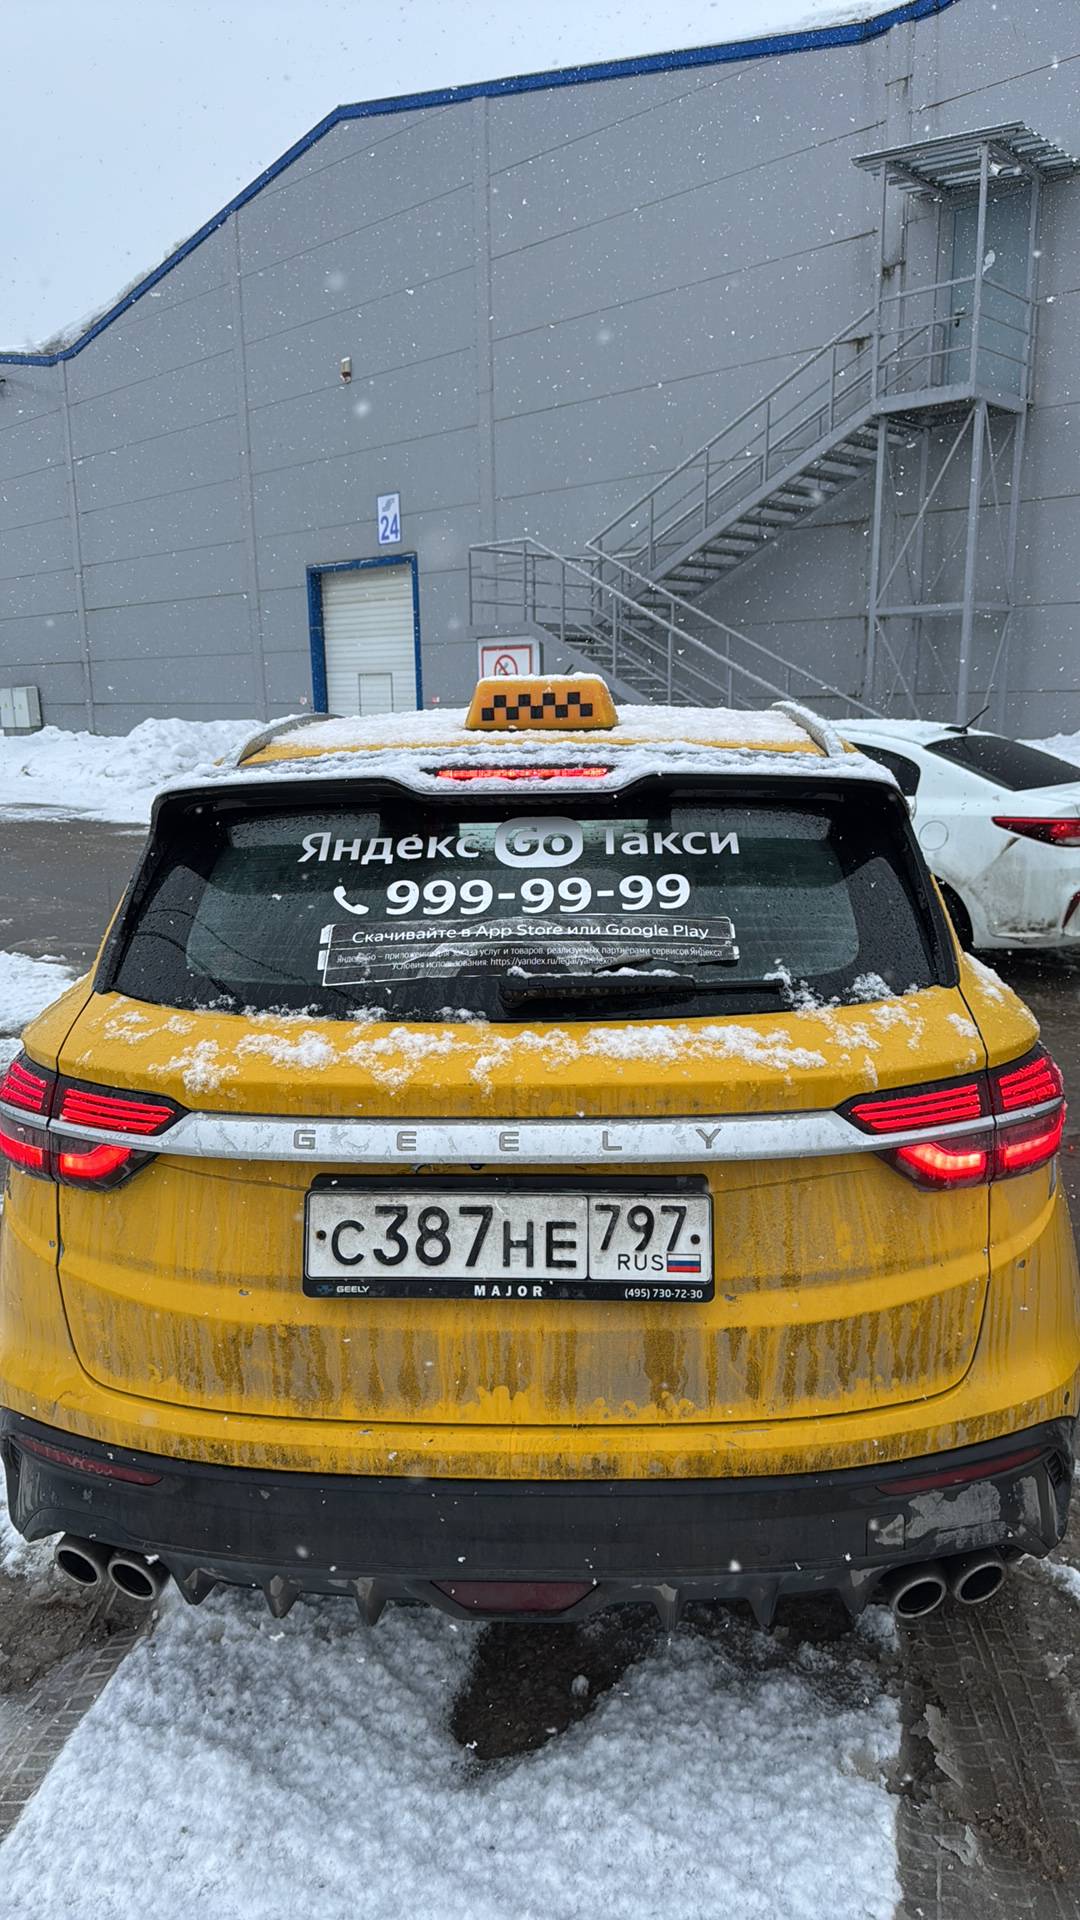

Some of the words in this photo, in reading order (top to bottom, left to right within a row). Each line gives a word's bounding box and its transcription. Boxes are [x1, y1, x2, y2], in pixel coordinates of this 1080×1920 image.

[380, 513, 399, 541] 24
[297, 831, 481, 865] Яндекс
[502, 825, 576, 859] Go
[386, 873, 692, 916] 999-99-99
[352, 927, 457, 944] Скачивайте
[461, 928, 471, 938] в
[475, 925, 512, 939] App
[516, 924, 563, 937] Store
[567, 926, 601, 935] или
[605, 923, 669, 938] Google
[672, 924, 709, 940] Play
[480, 947, 501, 957] услуг
[651, 947, 690, 957] сервисов
[690, 946, 723, 957] Яндекса
[293, 1127, 722, 1152] GEELY
[595, 1204, 688, 1252] 797
[617, 1253, 664, 1271] RUS
[336, 1285, 370, 1294] GEELY
[473, 1284, 543, 1298] MAJOR
[624, 1287, 651, 1300] (495)
[652, 1288, 704, 1300] 730-72-30
